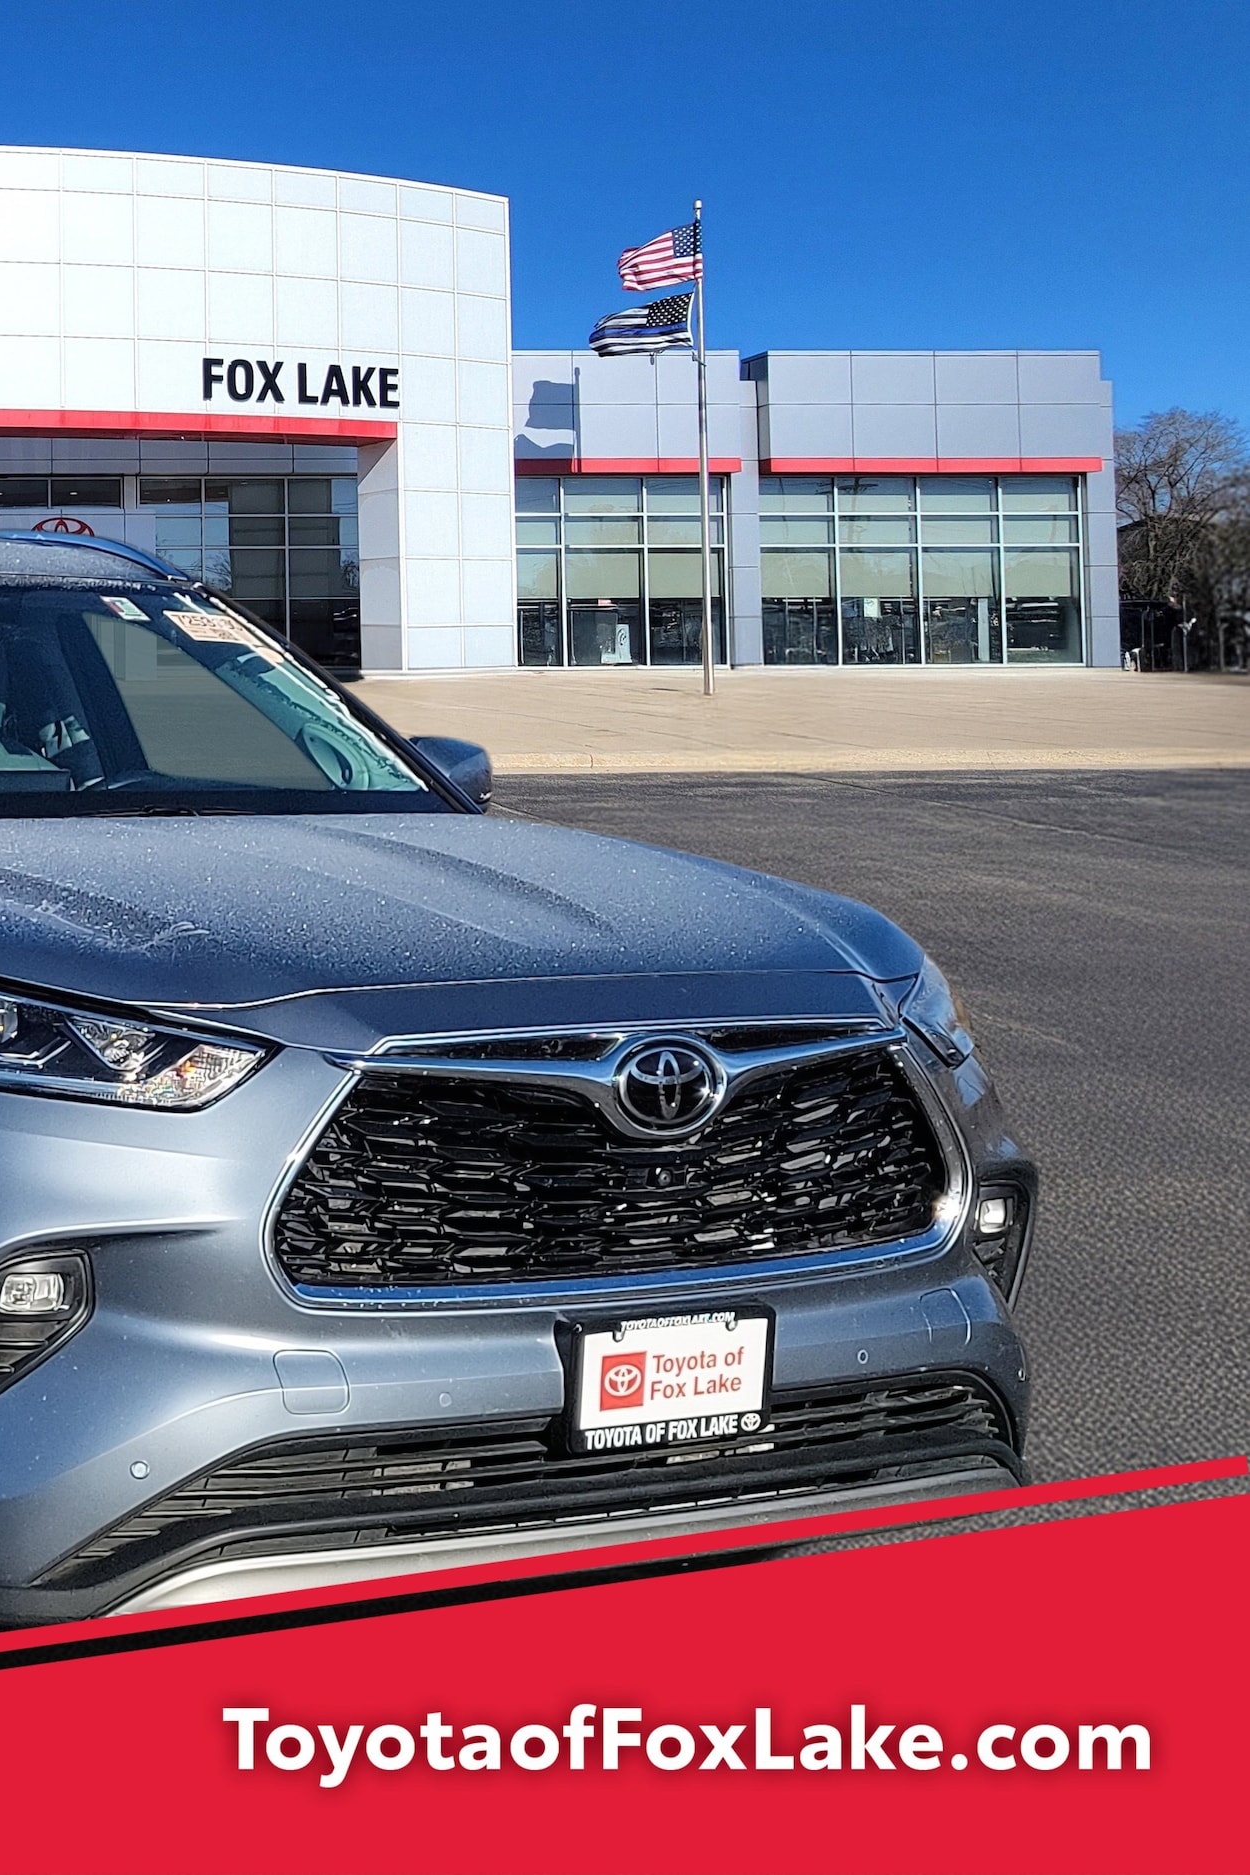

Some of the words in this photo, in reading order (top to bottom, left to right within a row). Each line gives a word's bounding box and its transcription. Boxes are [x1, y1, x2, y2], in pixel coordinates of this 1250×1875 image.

[202, 357, 285, 403] FOX
[297, 362, 400, 409] LAKE
[652, 1350, 717, 1377] Toyota
[724, 1346, 745, 1367] of
[650, 1380, 686, 1401] Fox
[693, 1374, 742, 1396] Lake
[584, 1426, 643, 1450] TOYOTA
[645, 1423, 665, 1444] OF
[668, 1419, 698, 1441] FOX
[701, 1414, 739, 1436] LAKE
